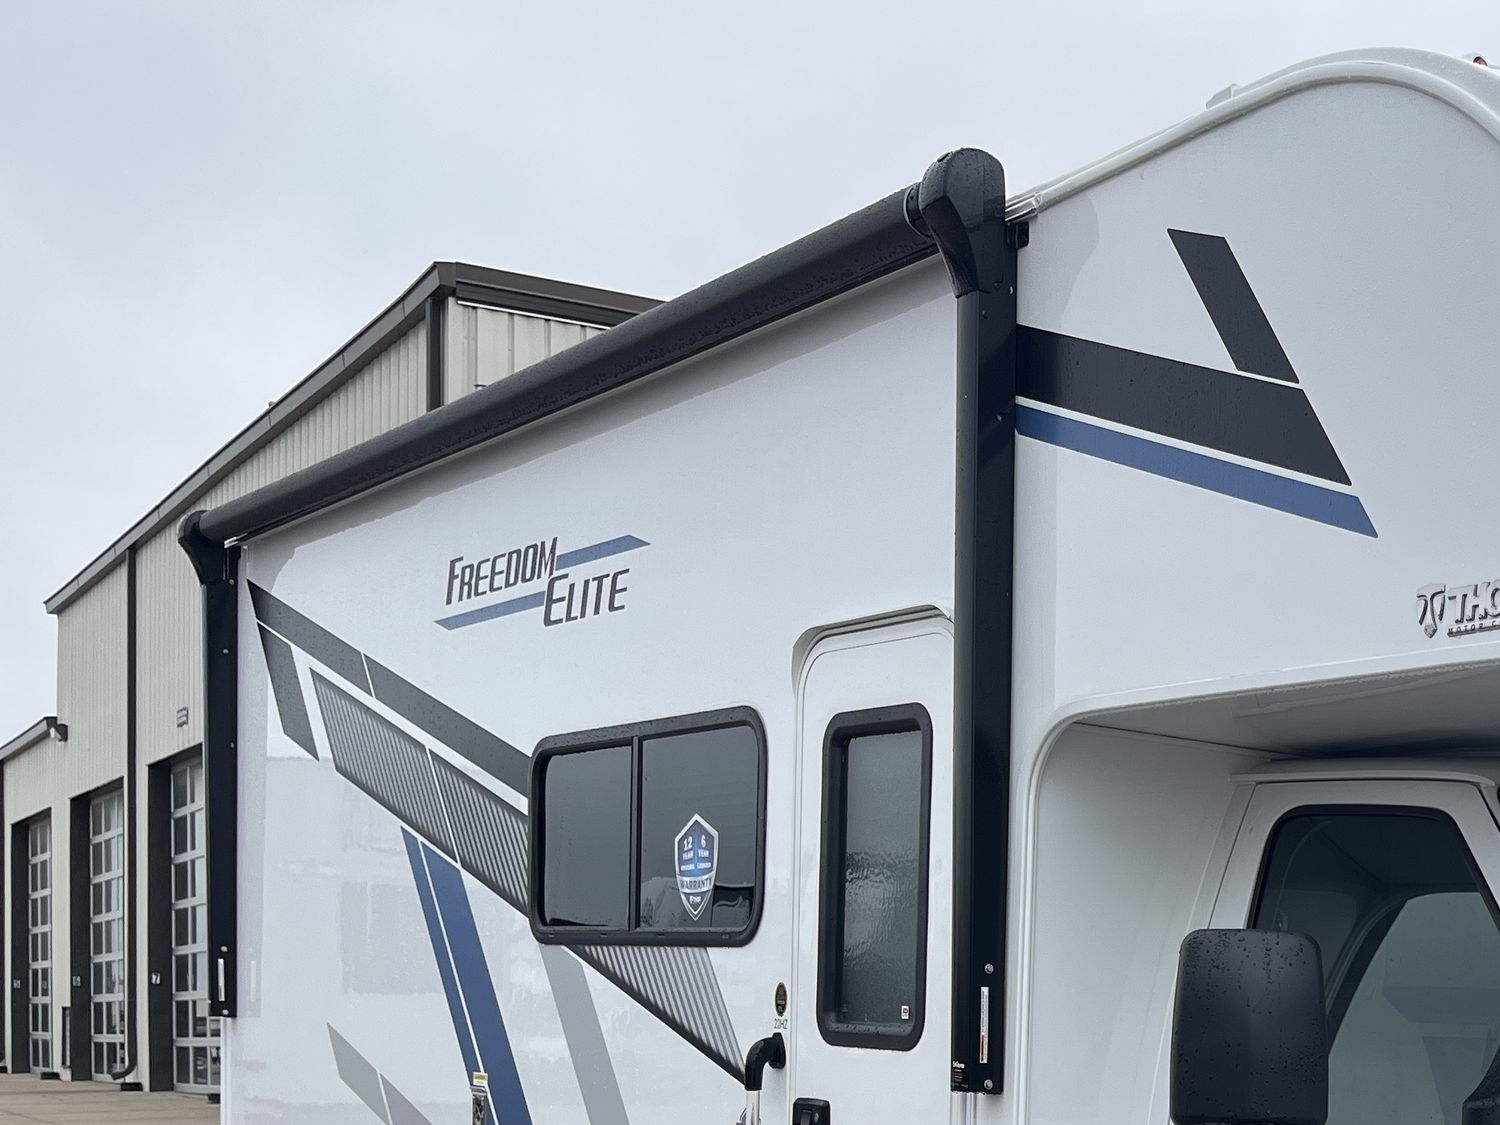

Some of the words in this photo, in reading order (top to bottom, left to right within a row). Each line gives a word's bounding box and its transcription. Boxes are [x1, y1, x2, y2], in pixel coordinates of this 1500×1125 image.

[446, 536, 558, 605] FREEDOM
[543, 568, 630, 627] ELITE
[1448, 623, 1484, 635] MOTOR
